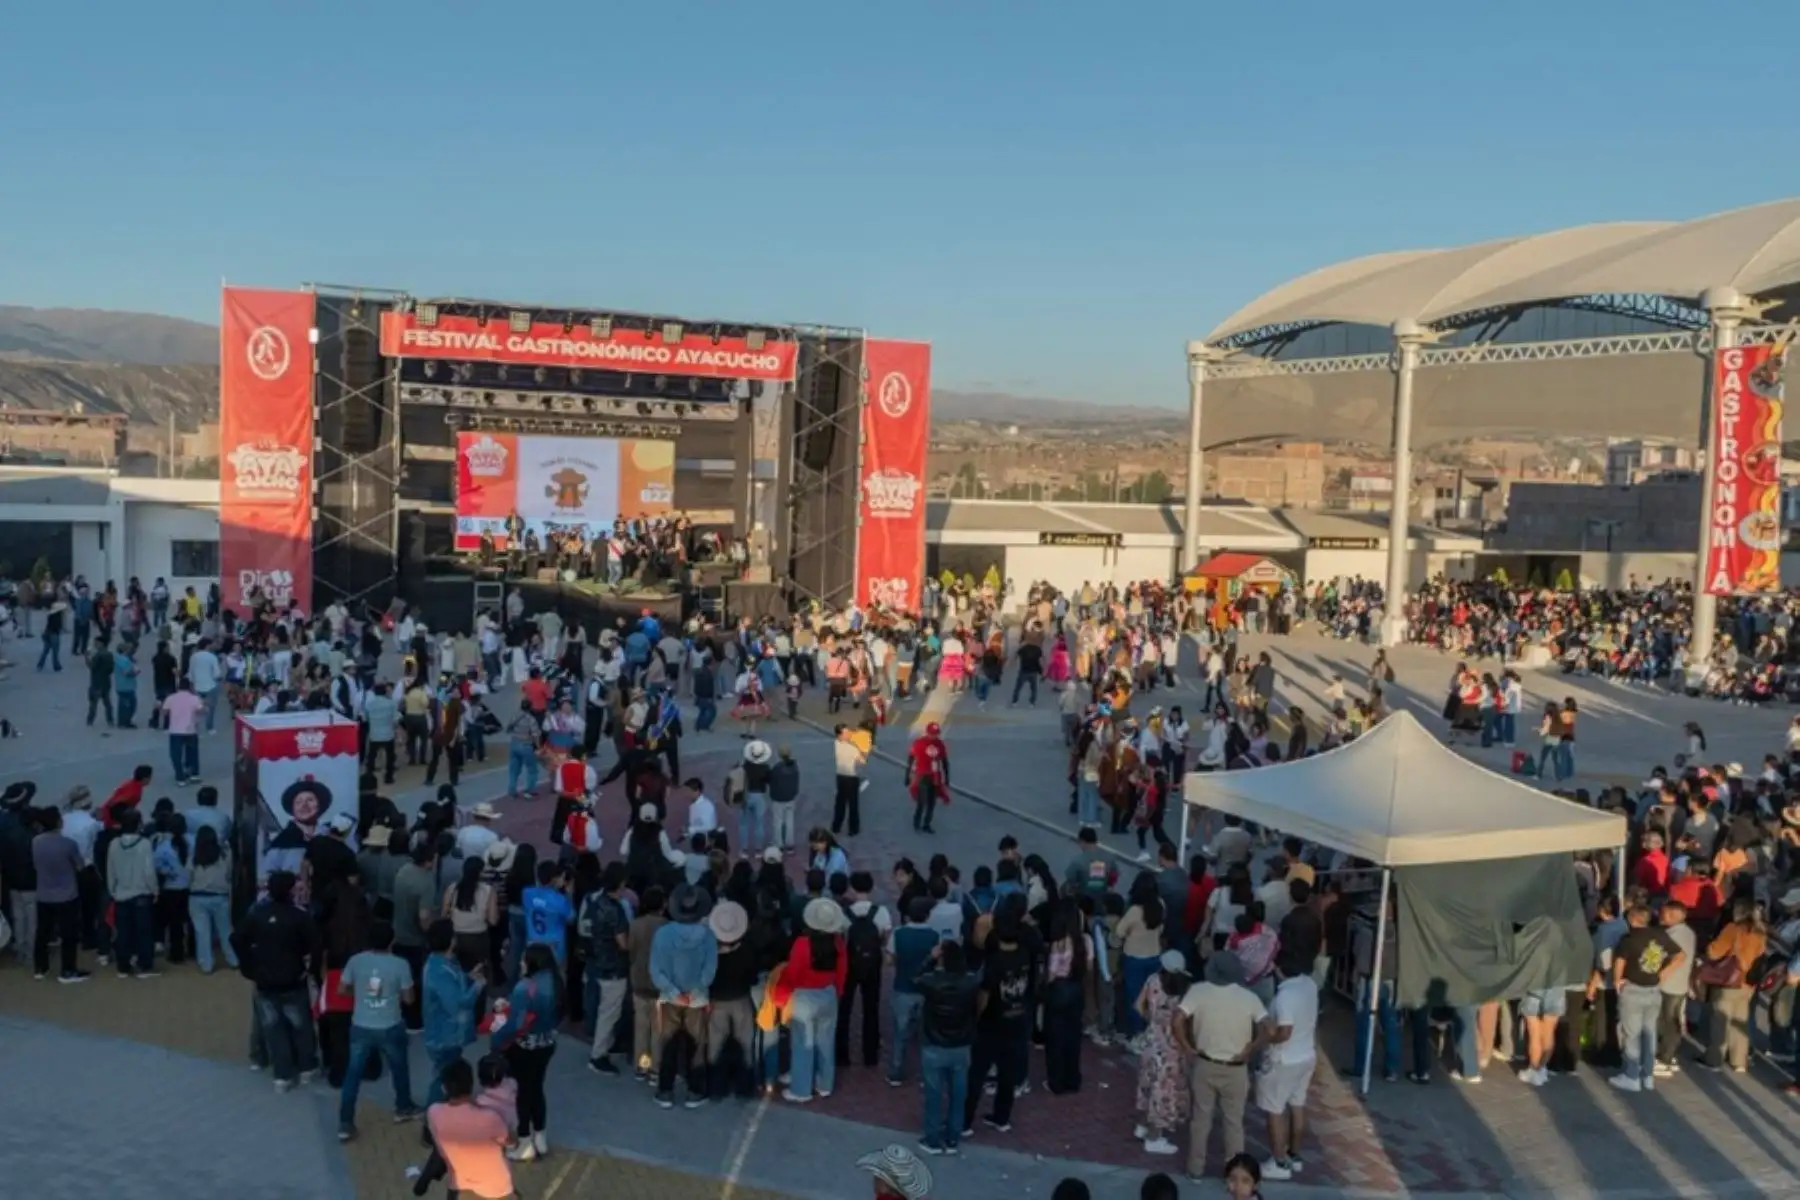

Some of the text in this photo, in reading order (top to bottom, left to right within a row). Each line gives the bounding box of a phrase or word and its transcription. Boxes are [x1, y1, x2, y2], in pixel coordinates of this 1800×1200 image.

[403, 330, 781, 371] FESTIVAL GASTRONÓMICO AYACUCHO
[240, 454, 294, 477] AYA
[532, 909, 547, 936] 6
